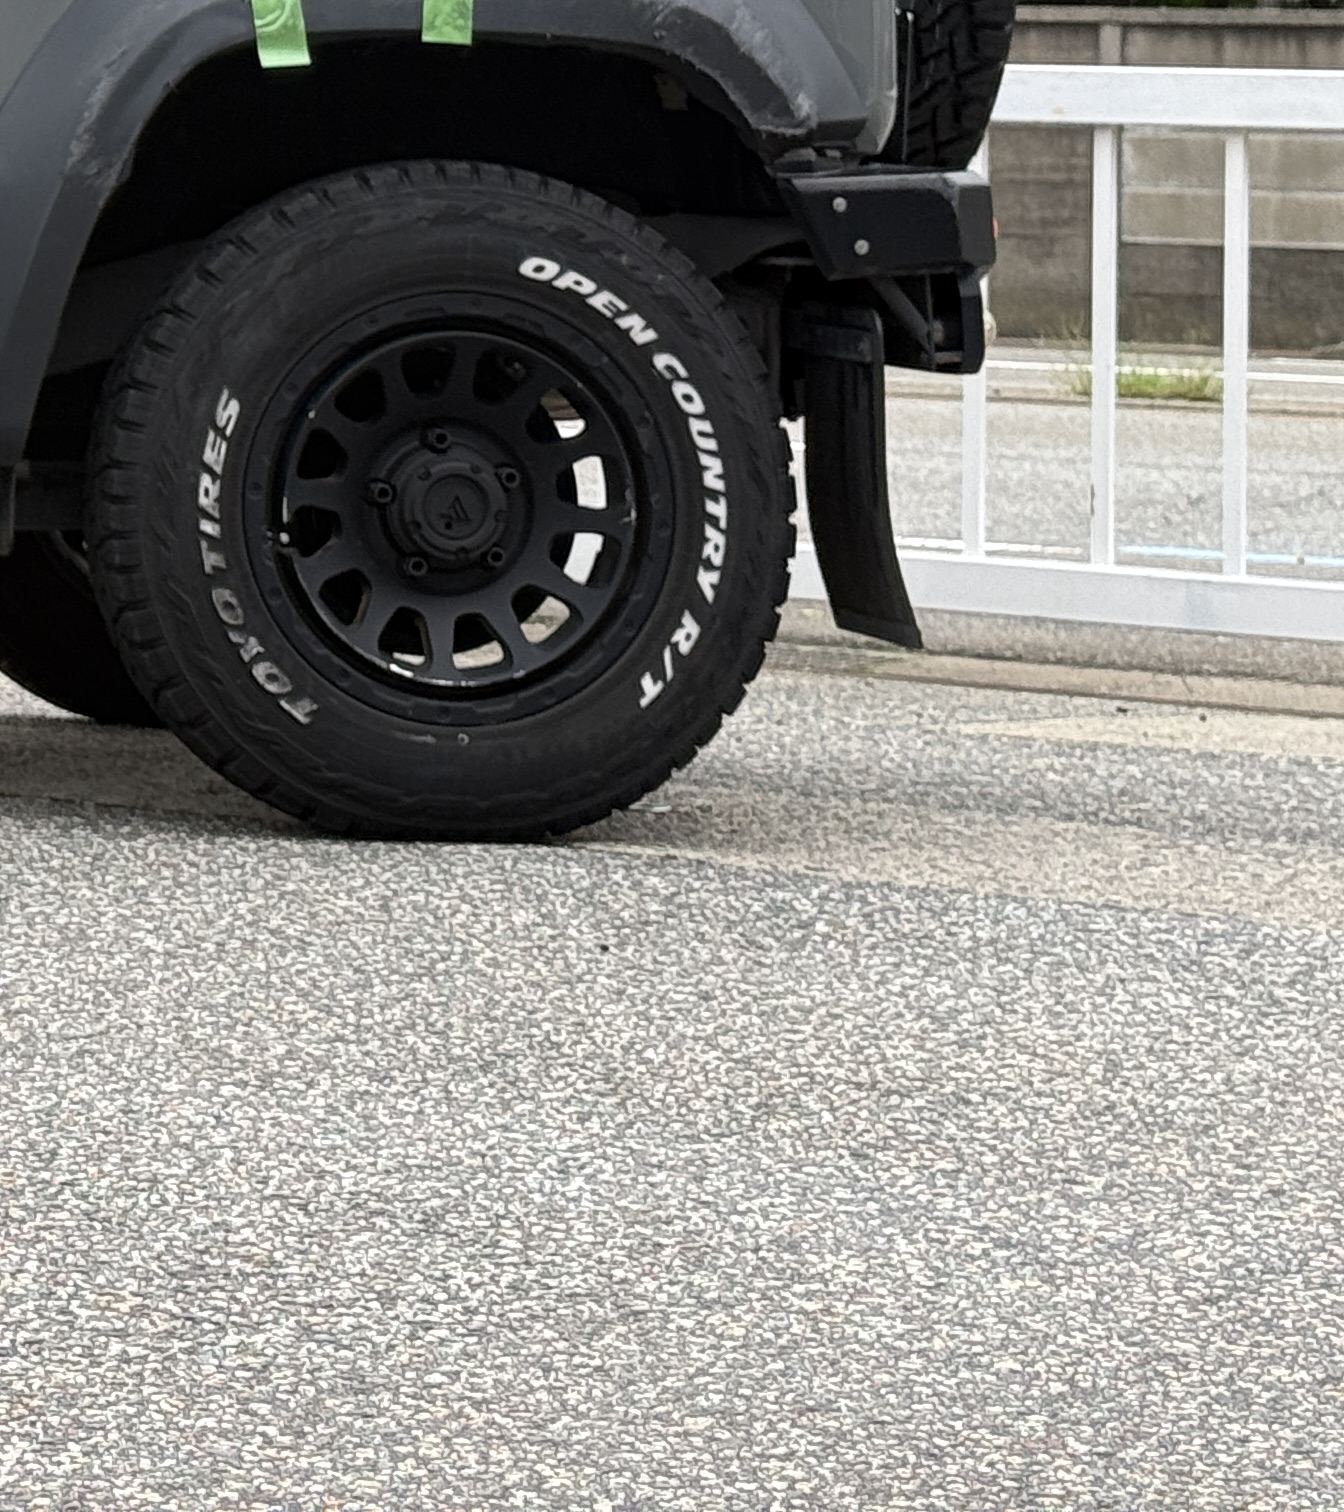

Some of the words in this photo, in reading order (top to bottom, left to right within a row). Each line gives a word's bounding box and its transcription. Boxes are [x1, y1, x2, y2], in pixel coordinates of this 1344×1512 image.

[517, 255, 659, 347] OPEN
[197, 387, 242, 574] TIRES
[651, 351, 729, 605] COUNTRY
[638, 608, 702, 709] R/T
